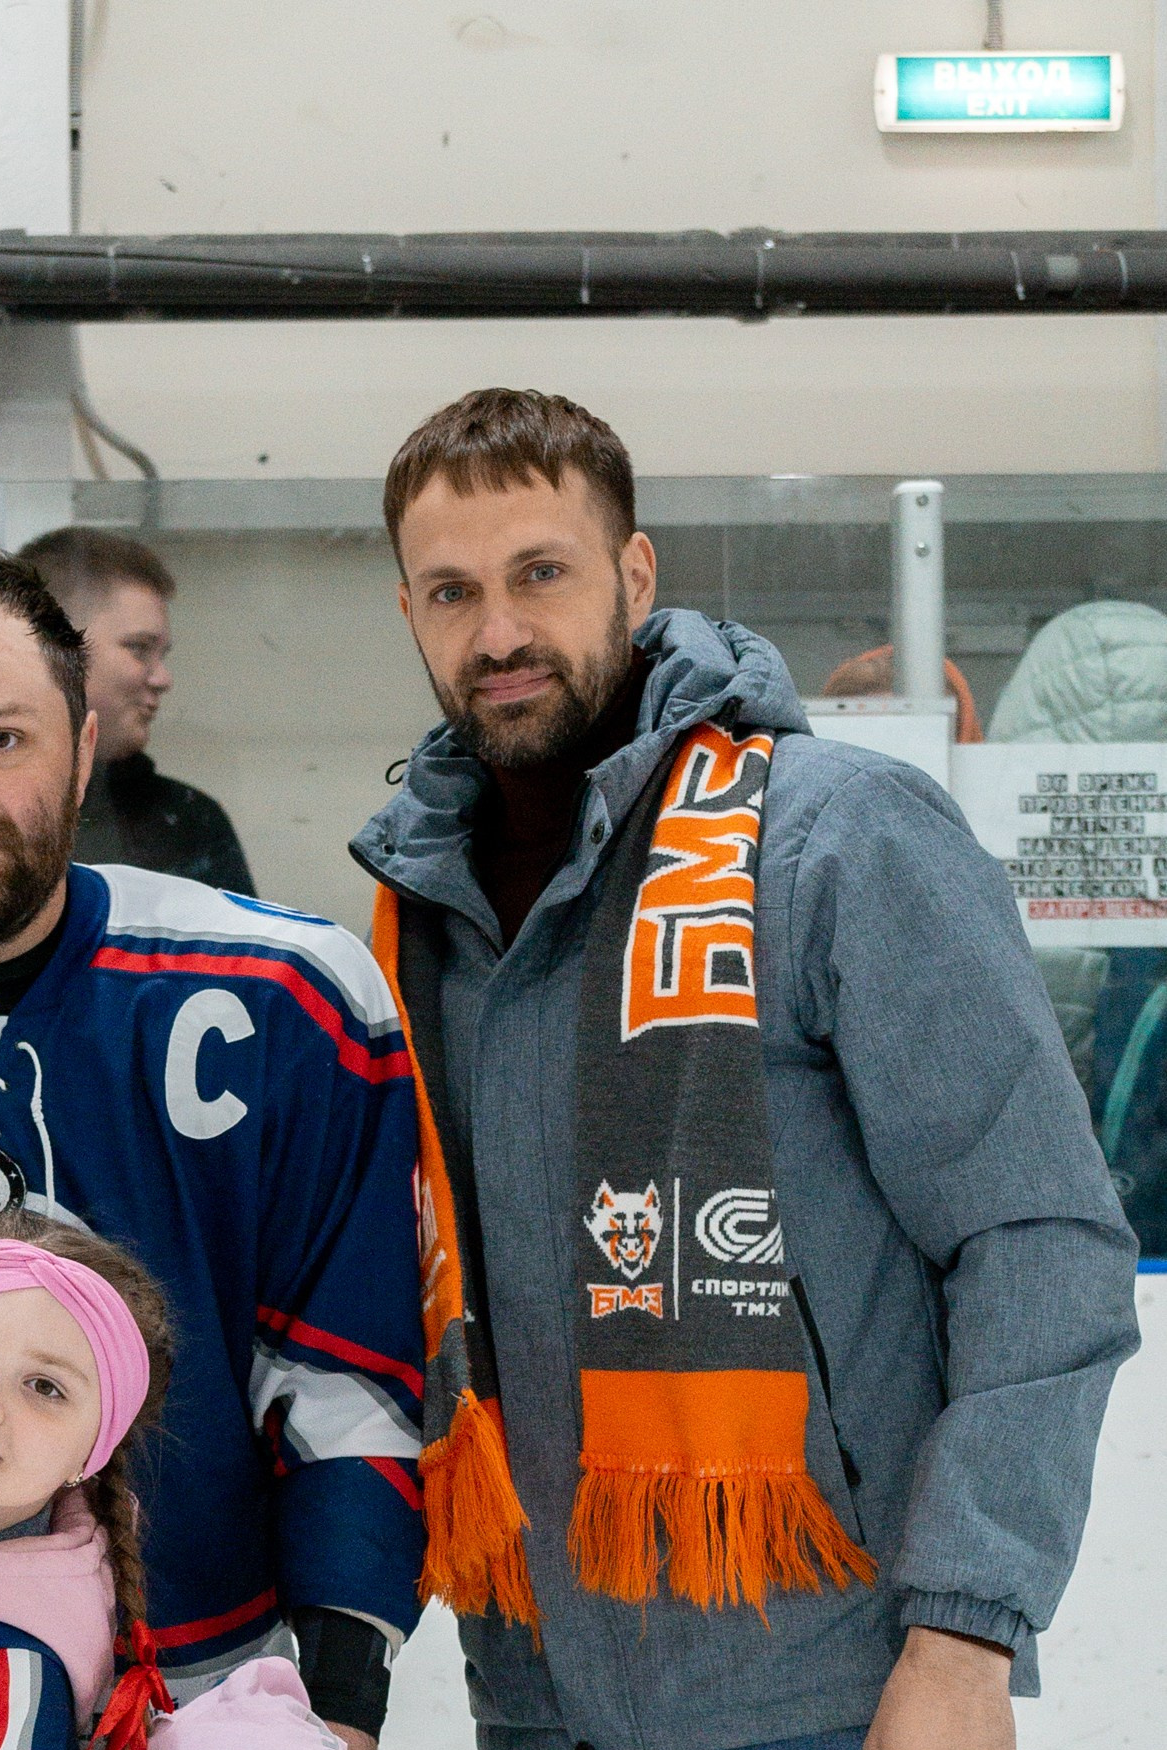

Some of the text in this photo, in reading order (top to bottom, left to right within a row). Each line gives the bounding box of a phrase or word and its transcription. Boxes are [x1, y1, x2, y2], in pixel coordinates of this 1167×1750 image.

[934, 60, 1073, 96] ВЫХОД
[966, 96, 1033, 116] EXIT
[1019, 795, 1167, 813] ПРОВЕДЕНИ
[1018, 837, 1167, 857] НАХОЖДЕНИ
[164, 988, 255, 1140] C
[586, 1282, 664, 1319] БМЗ
[731, 1301, 782, 1317] ТМХ
